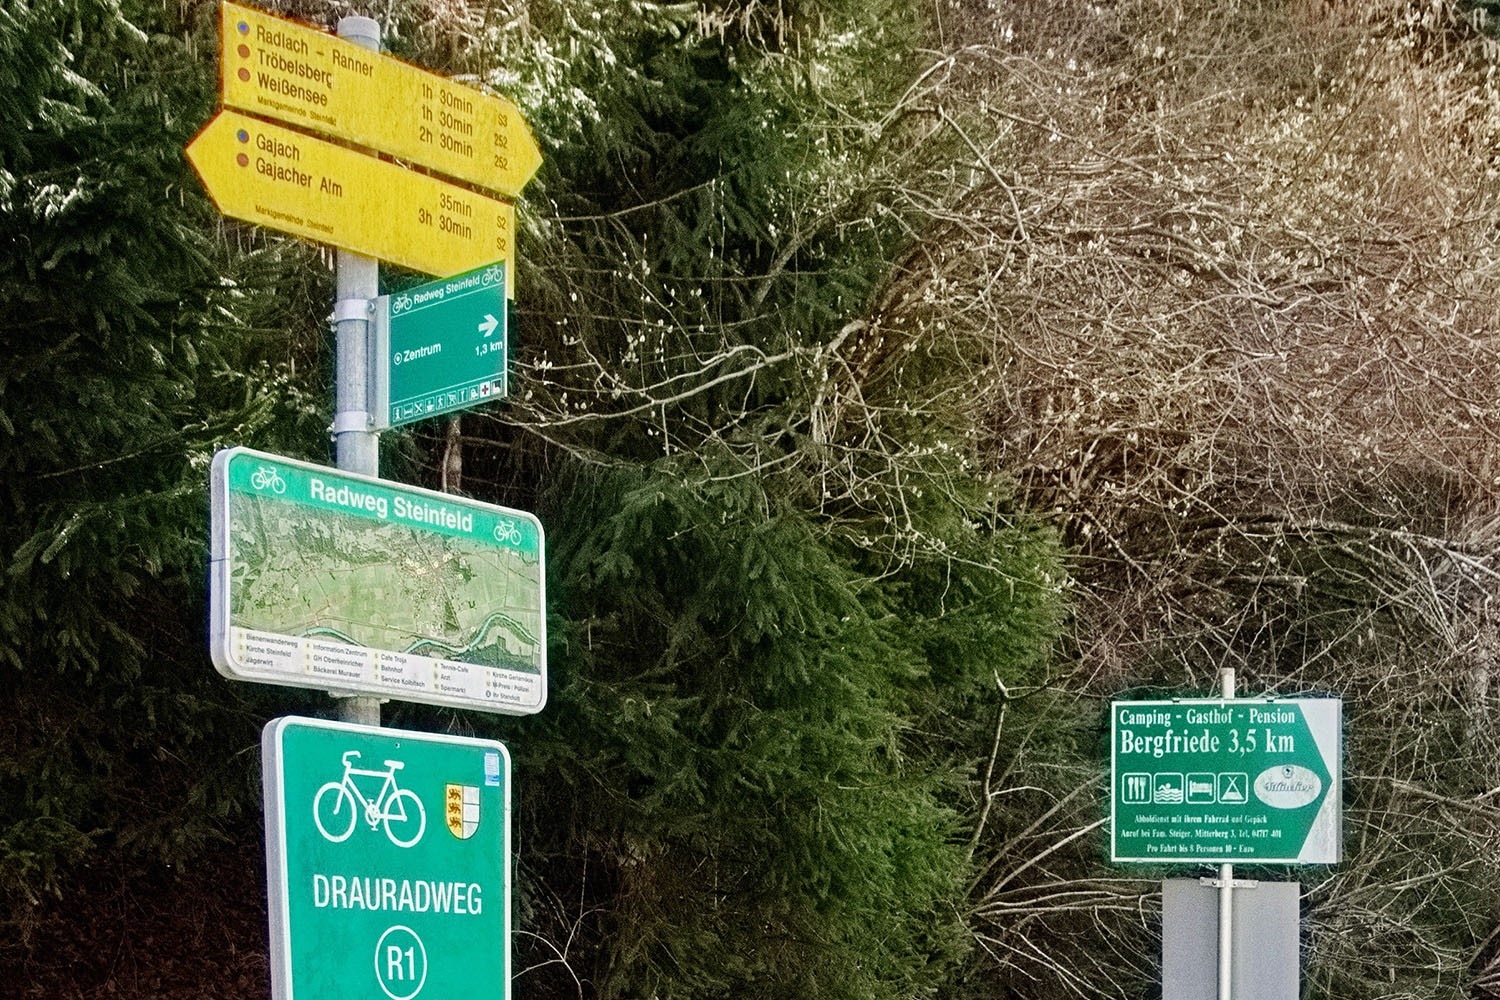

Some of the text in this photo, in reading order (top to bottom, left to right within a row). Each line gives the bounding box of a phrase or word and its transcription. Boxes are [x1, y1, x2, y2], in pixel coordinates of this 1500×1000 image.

[256, 25, 308, 55] Radlach
[332, 49, 374, 78] Ranner
[422, 83, 433, 100] 1h
[440, 89, 472, 115] 30min
[498, 114, 508, 127] S3
[257, 48, 508, 149] Tröbelsberg 1h 30min 252
[257, 96, 307, 117] Marktgemeinde
[257, 72, 508, 170] Weißensee 2h 30min 252
[256, 133, 506, 230] Gajach 35min S2
[255, 204, 334, 234] Marktgemeinde Steinfeld
[256, 157, 506, 252] Gajacher Alm 3h 30min S2
[414, 275, 480, 304] Radweg Steinfeld
[404, 341, 503, 362] Zentrum 1,3 km
[310, 478, 473, 533] Radweg Steinfeld
[1119, 709, 1171, 727] Camping
[1186, 708, 1234, 725] Gasthof
[1250, 708, 1295, 724] Pension
[1120, 728, 1295, 758] Bergfriede 3,5 km
[1121, 829, 1139, 838] Anruf
[1141, 829, 1150, 838] bei
[1195, 829, 1228, 839] Mitterberg
[1171, 814, 1181, 823] mit
[1184, 814, 1201, 823] ihrem
[1204, 814, 1229, 823] Fahrrad
[1231, 815, 1243, 823] und
[1244, 814, 1268, 825] Gepäck
[1147, 844, 1158, 853] Pro
[1160, 844, 1177, 853] Fahrt
[1179, 844, 1188, 853] bis
[1196, 844, 1223, 853] Personen
[1239, 844, 1255, 853] Euro
[313, 873, 482, 915] DRAURADWEG
[387, 945, 415, 981] R1
